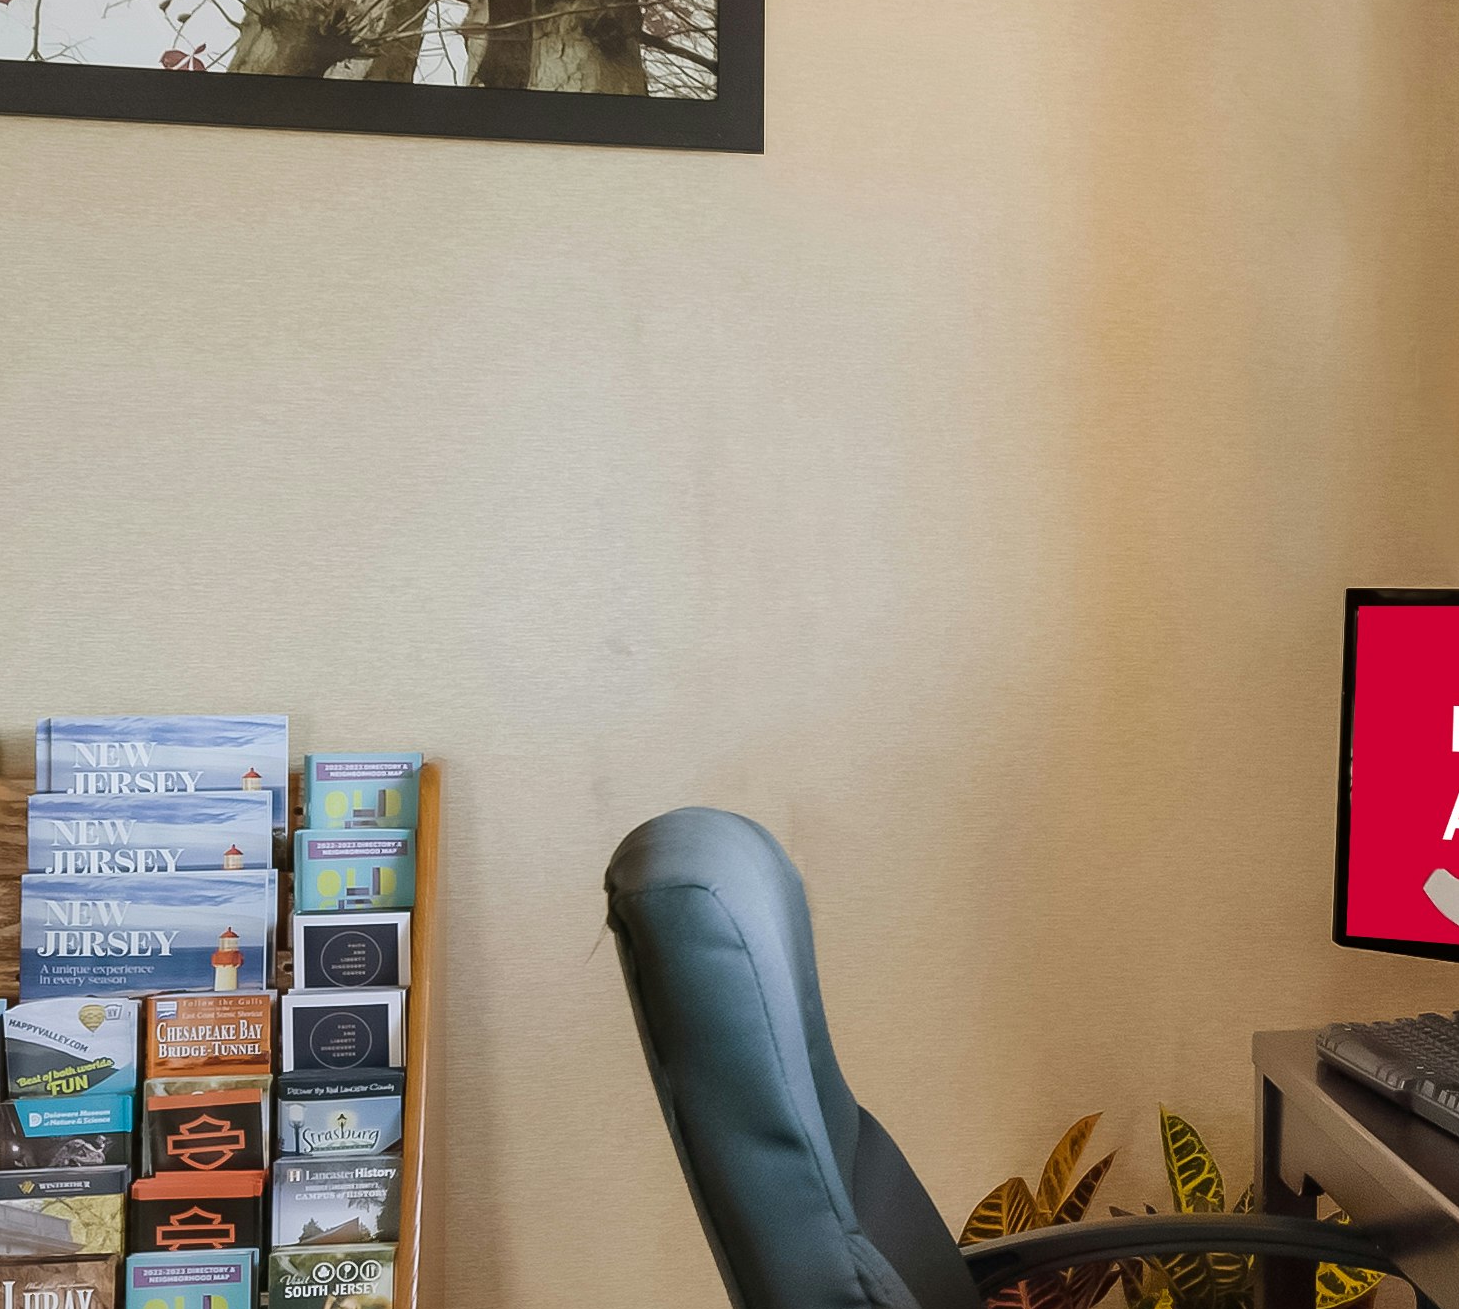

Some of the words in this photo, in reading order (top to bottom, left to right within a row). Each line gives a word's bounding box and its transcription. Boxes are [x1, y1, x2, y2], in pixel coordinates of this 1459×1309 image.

[71, 741, 158, 769] NEW
[66, 770, 204, 794] JERSEY
[51, 820, 137, 845] NEW
[45, 848, 185, 875] JERSEY
[44, 900, 132, 927] NEW
[36, 930, 180, 957] JERSEY
[52, 964, 91, 976] unique
[92, 963, 155, 976] experience
[53, 976, 85, 986] every
[88, 976, 127, 984] season
[8, 1018, 89, 1052] HAPPYVALLEY.COM
[156, 1021, 236, 1043] CHESAPEAKE
[239, 1019, 263, 1039] BAY
[158, 1041, 262, 1059] BRIDGE-TUNNEL
[47, 1074, 89, 1096] FUN
[302, 1128, 380, 1153] Strasburg
[305, 1167, 397, 1181] LancasterHistory
[280, 1274, 311, 1286] Visit
[284, 1284, 328, 1299] SOUTH
[332, 1282, 379, 1296] JERSEY
